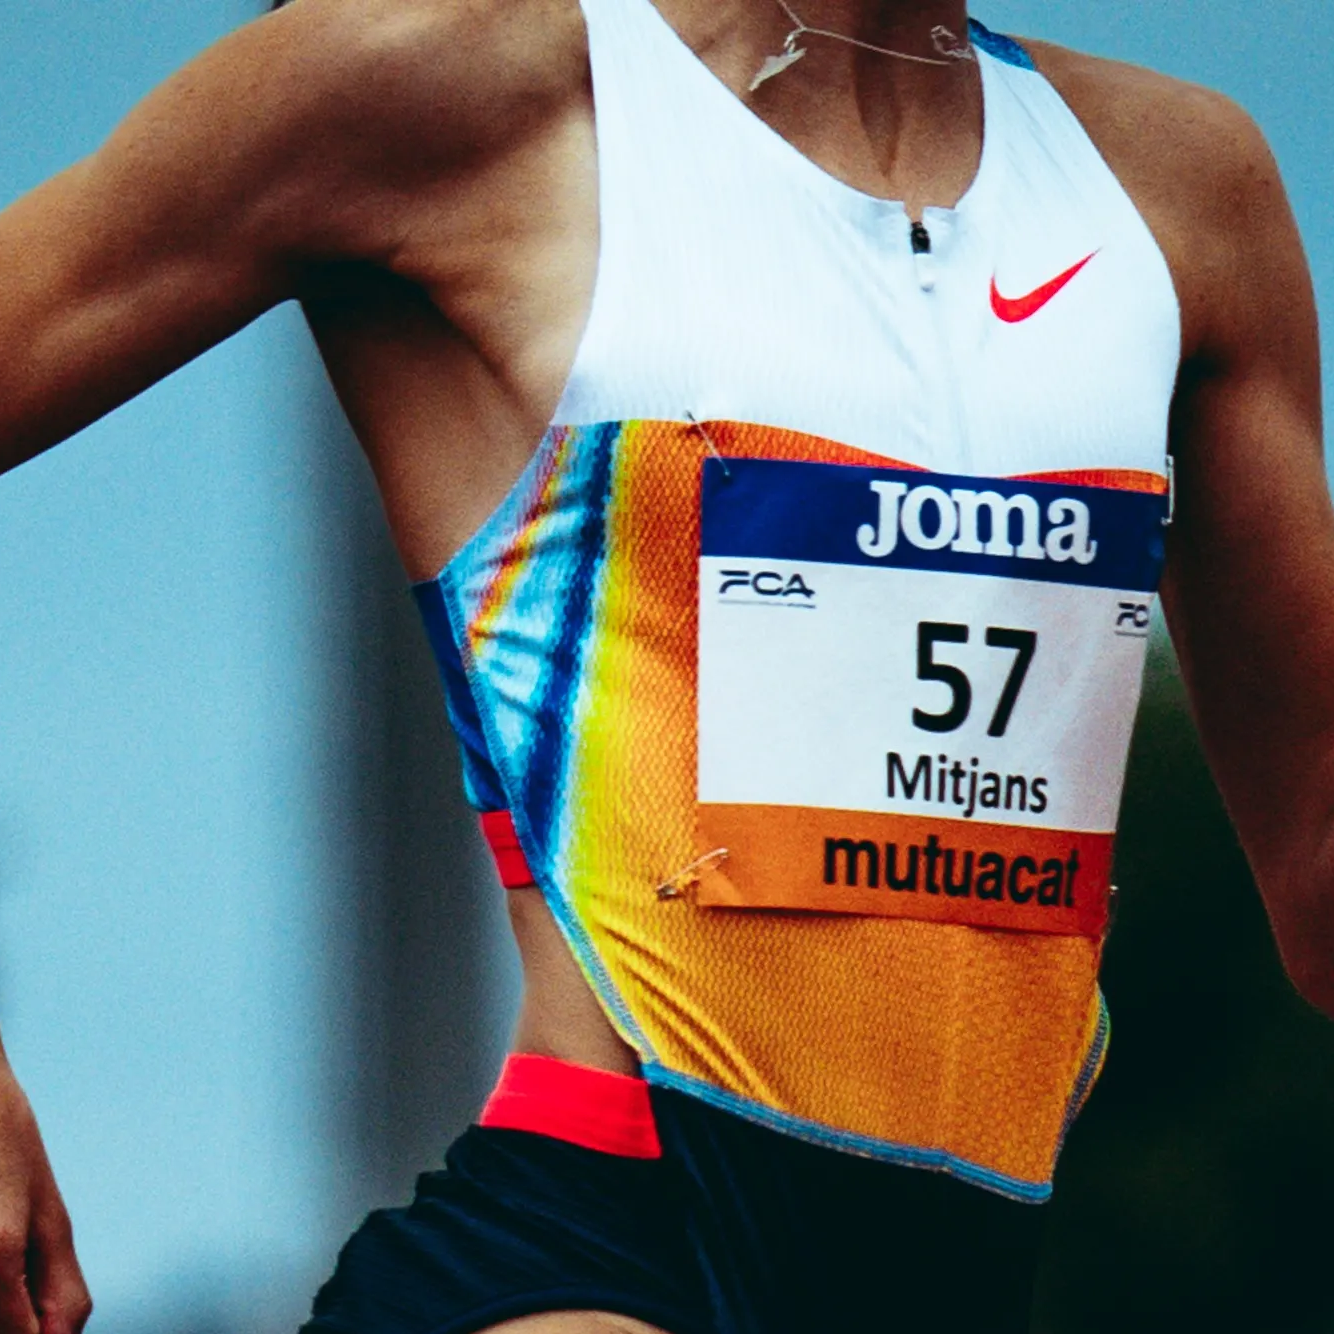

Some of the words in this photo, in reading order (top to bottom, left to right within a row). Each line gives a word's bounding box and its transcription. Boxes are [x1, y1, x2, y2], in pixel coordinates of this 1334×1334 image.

[718, 569, 816, 599] FCA
[911, 621, 1037, 738] 57
[886, 751, 1048, 818] Mitjans
[823, 835, 1080, 908] mutuacat
